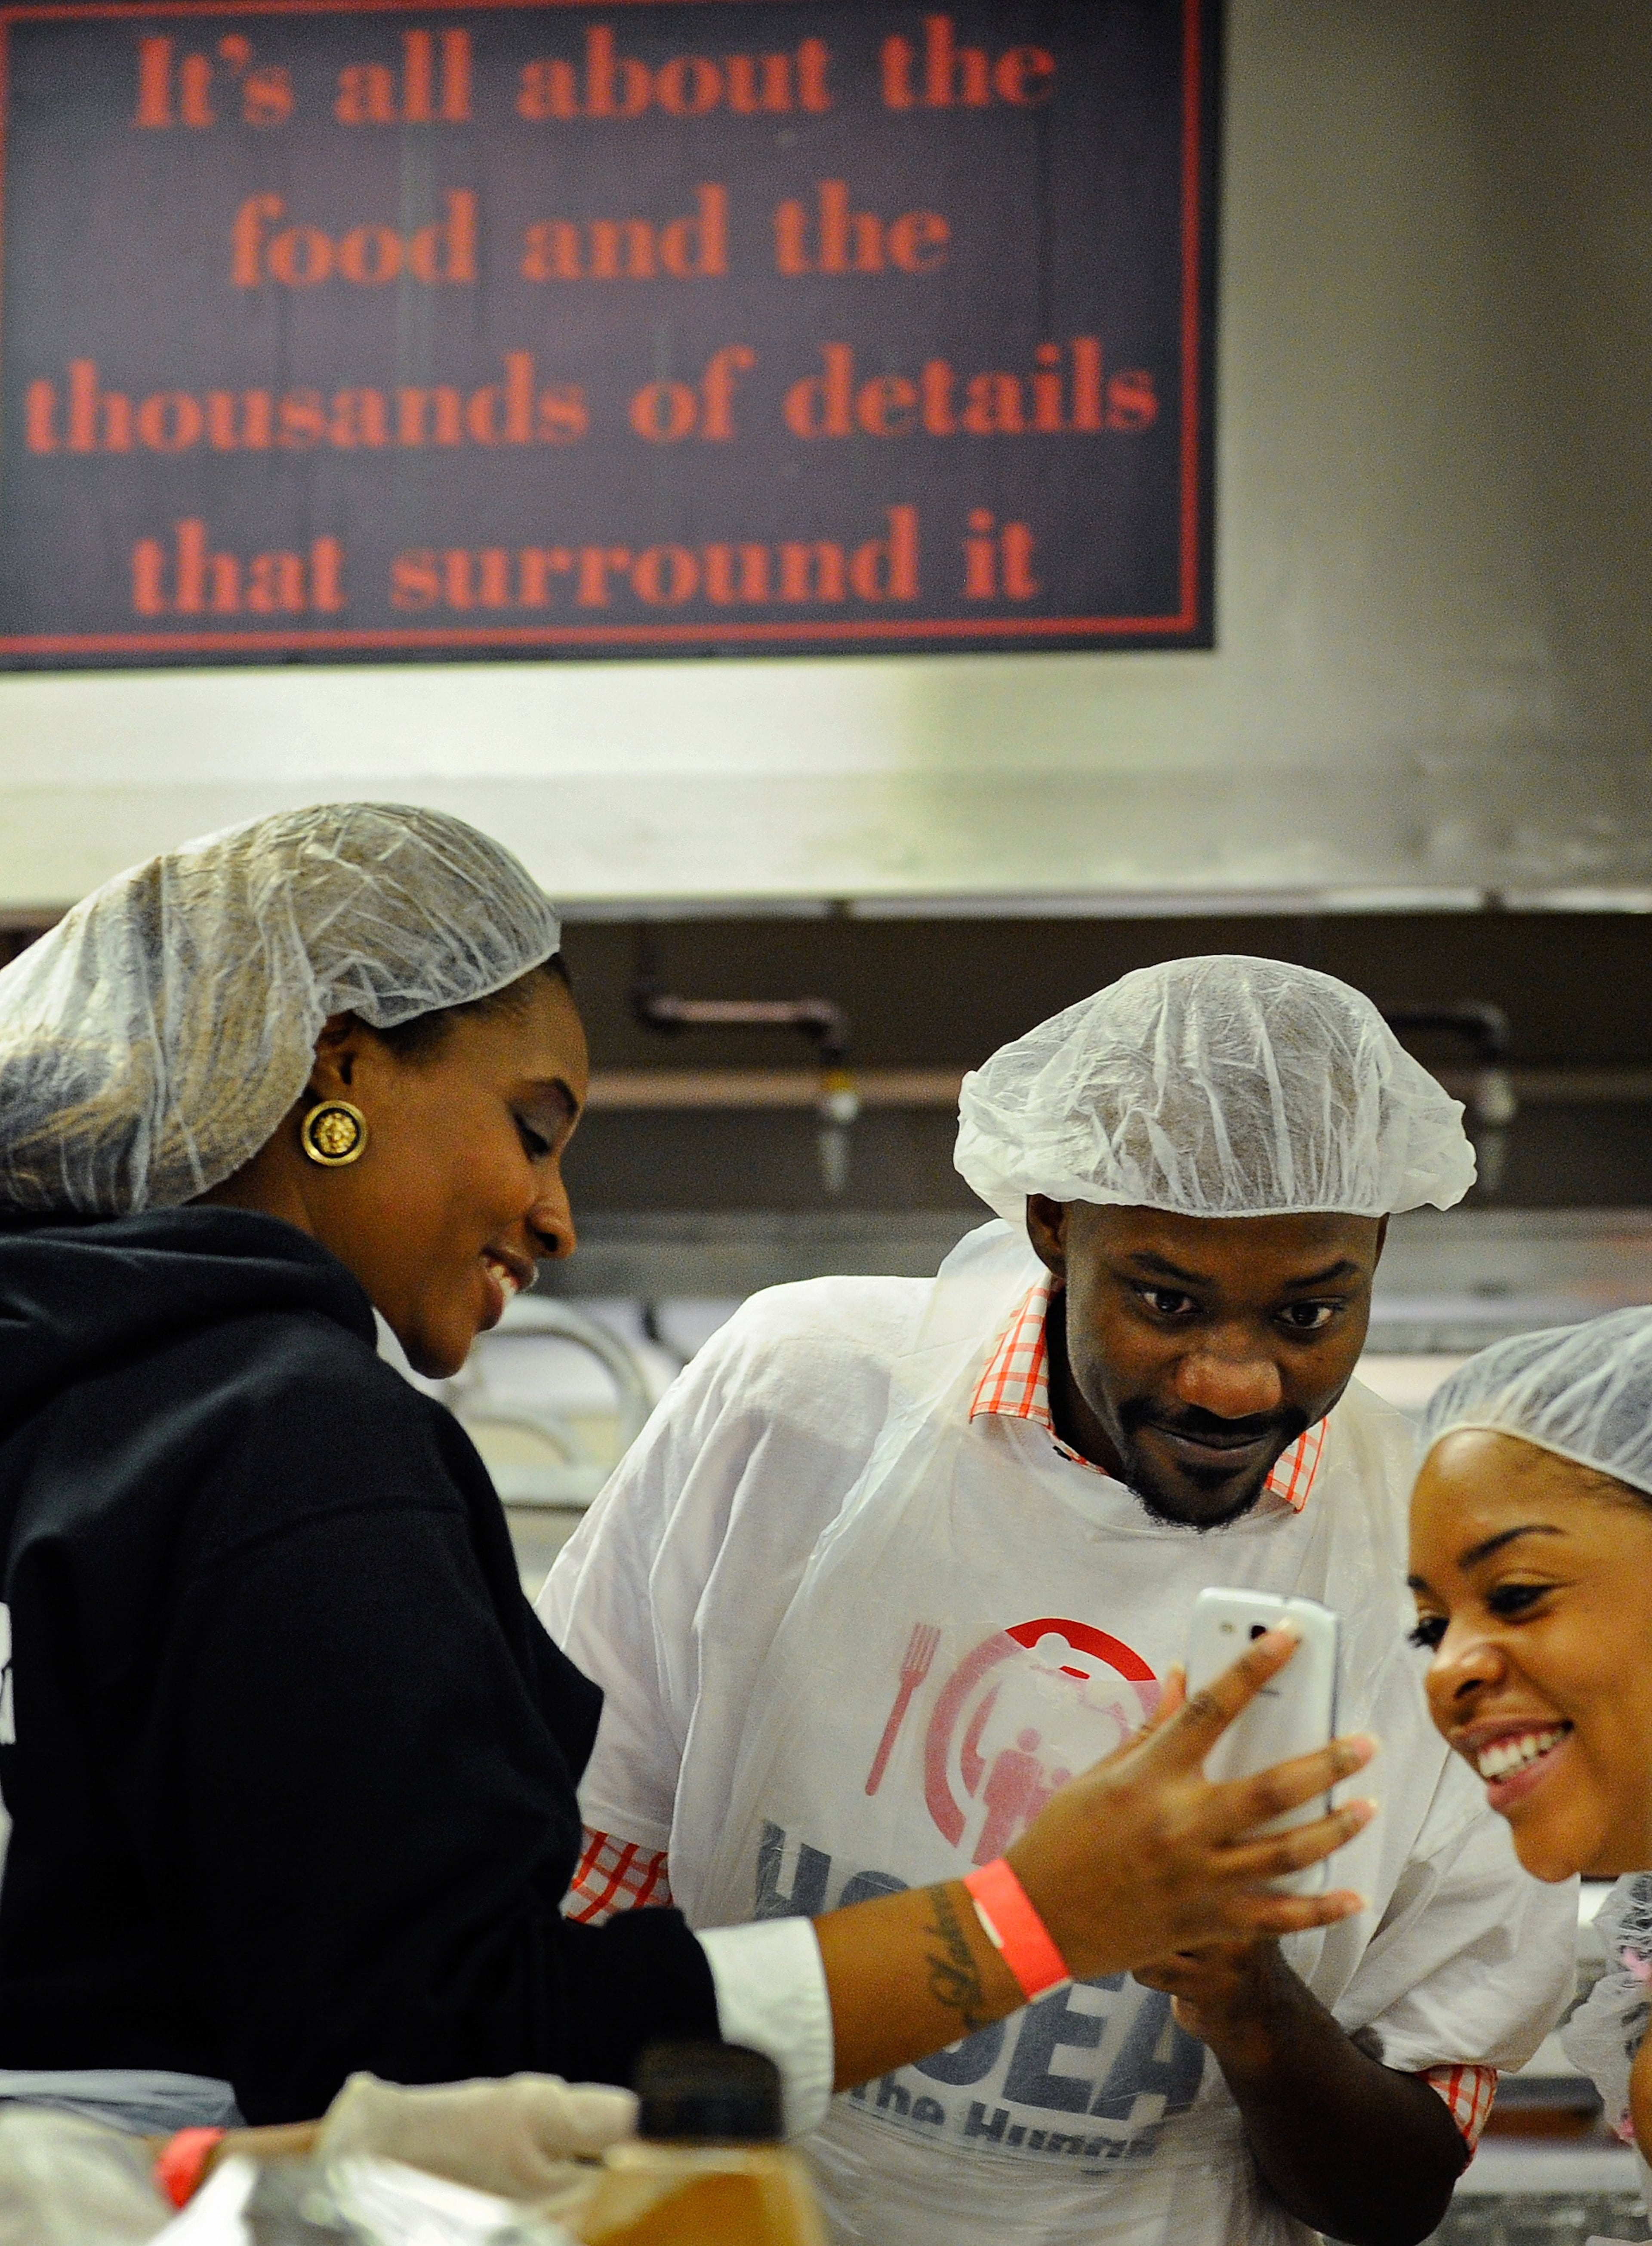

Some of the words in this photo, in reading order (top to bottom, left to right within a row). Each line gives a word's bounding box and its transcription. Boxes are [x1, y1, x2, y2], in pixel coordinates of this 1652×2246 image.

[134, 34, 295, 128] It's
[336, 28, 472, 124] all
[517, 26, 831, 119] about
[881, 15, 1055, 108] the
[231, 190, 476, 287] food
[521, 183, 728, 281] and
[774, 180, 949, 275] the
[26, 351, 589, 453] thousands
[629, 346, 755, 441] of
[784, 336, 1158, 438] details
[132, 519, 344, 616] that
[391, 505, 918, 610] surround
[965, 509, 1036, 600] it
